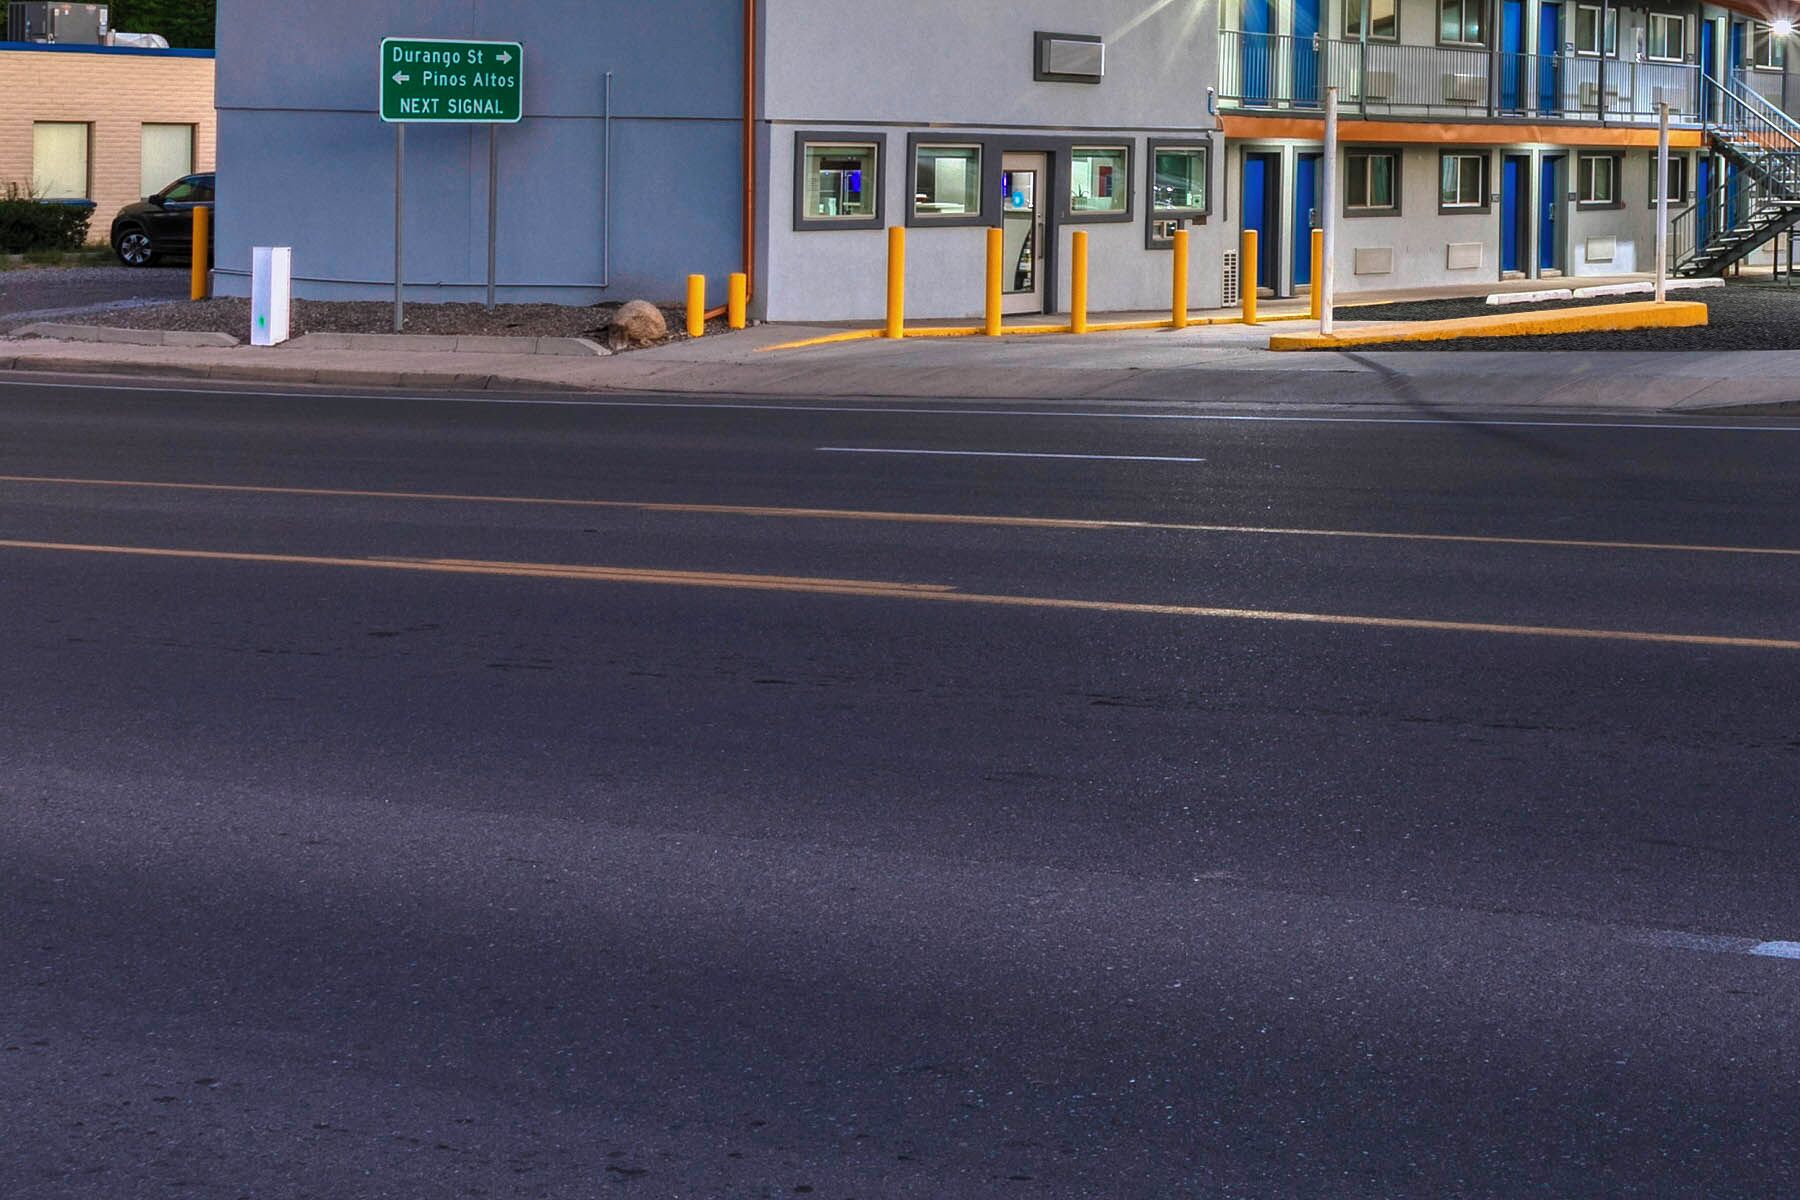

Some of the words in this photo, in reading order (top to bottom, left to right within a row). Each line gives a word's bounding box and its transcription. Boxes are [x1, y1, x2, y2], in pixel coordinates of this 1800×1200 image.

[393, 47, 460, 67] Durango
[467, 49, 483, 64] St
[423, 71, 466, 86] Pinos
[473, 72, 515, 87] Altos
[400, 98, 439, 113] NEXT
[448, 99, 503, 114] SIGNAL
